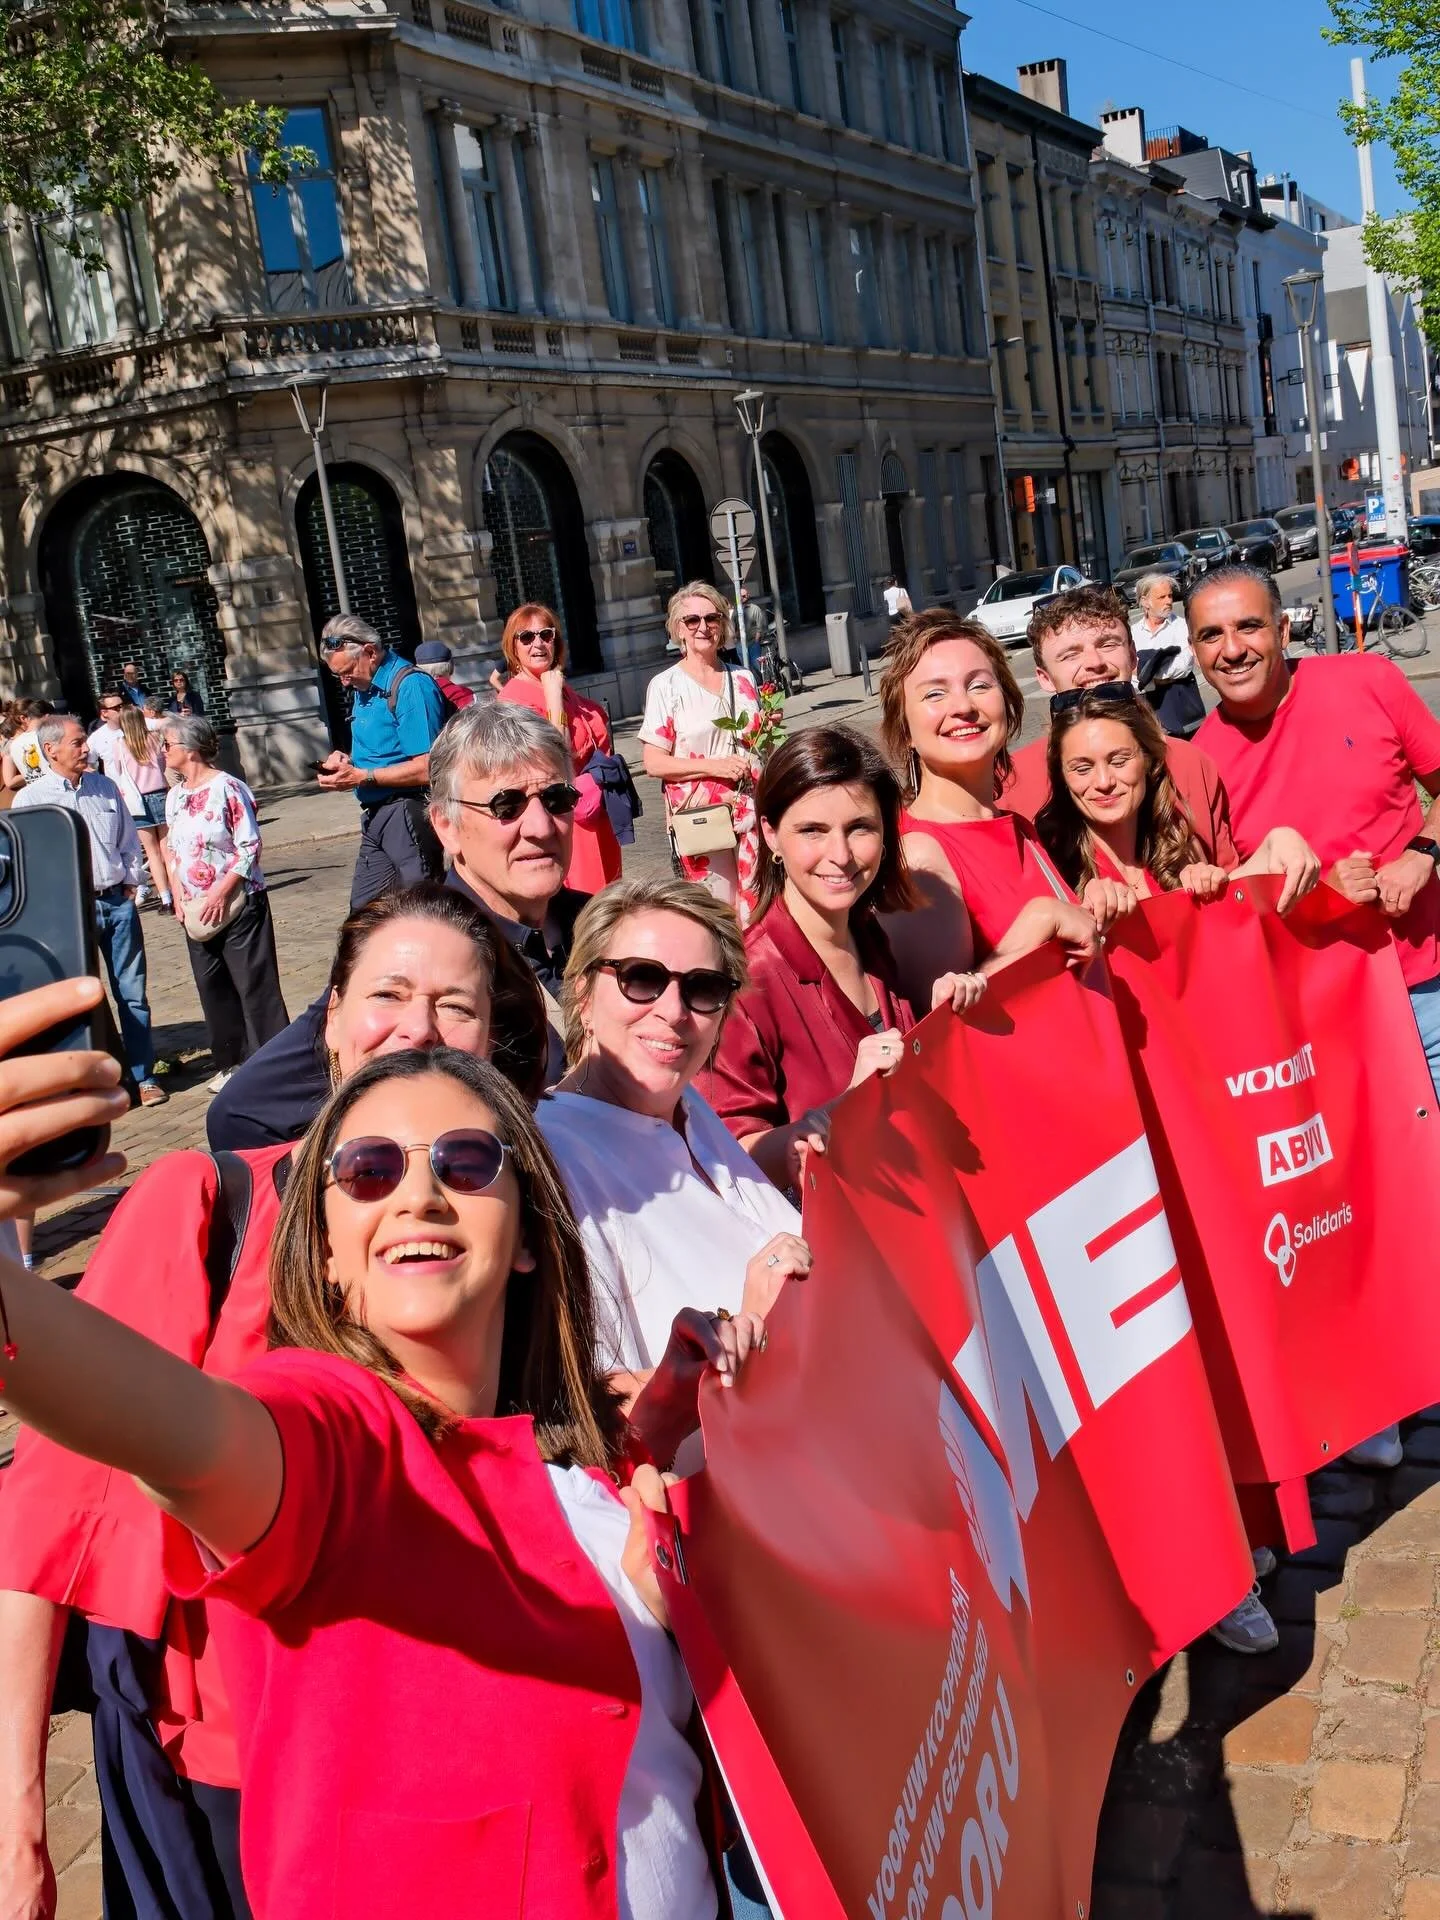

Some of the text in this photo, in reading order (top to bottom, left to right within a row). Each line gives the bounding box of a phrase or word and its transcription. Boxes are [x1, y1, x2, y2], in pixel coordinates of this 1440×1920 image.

[1368, 498, 1380, 514] P
[1293, 1202, 1353, 1249] Solidaris
[867, 1567, 970, 1920] VOOR UW KOOPKRACHT
[920, 1792, 946, 1880] UW
[942, 1618, 989, 1814] GEZONDHEID
[991, 1672, 1020, 1801] U
